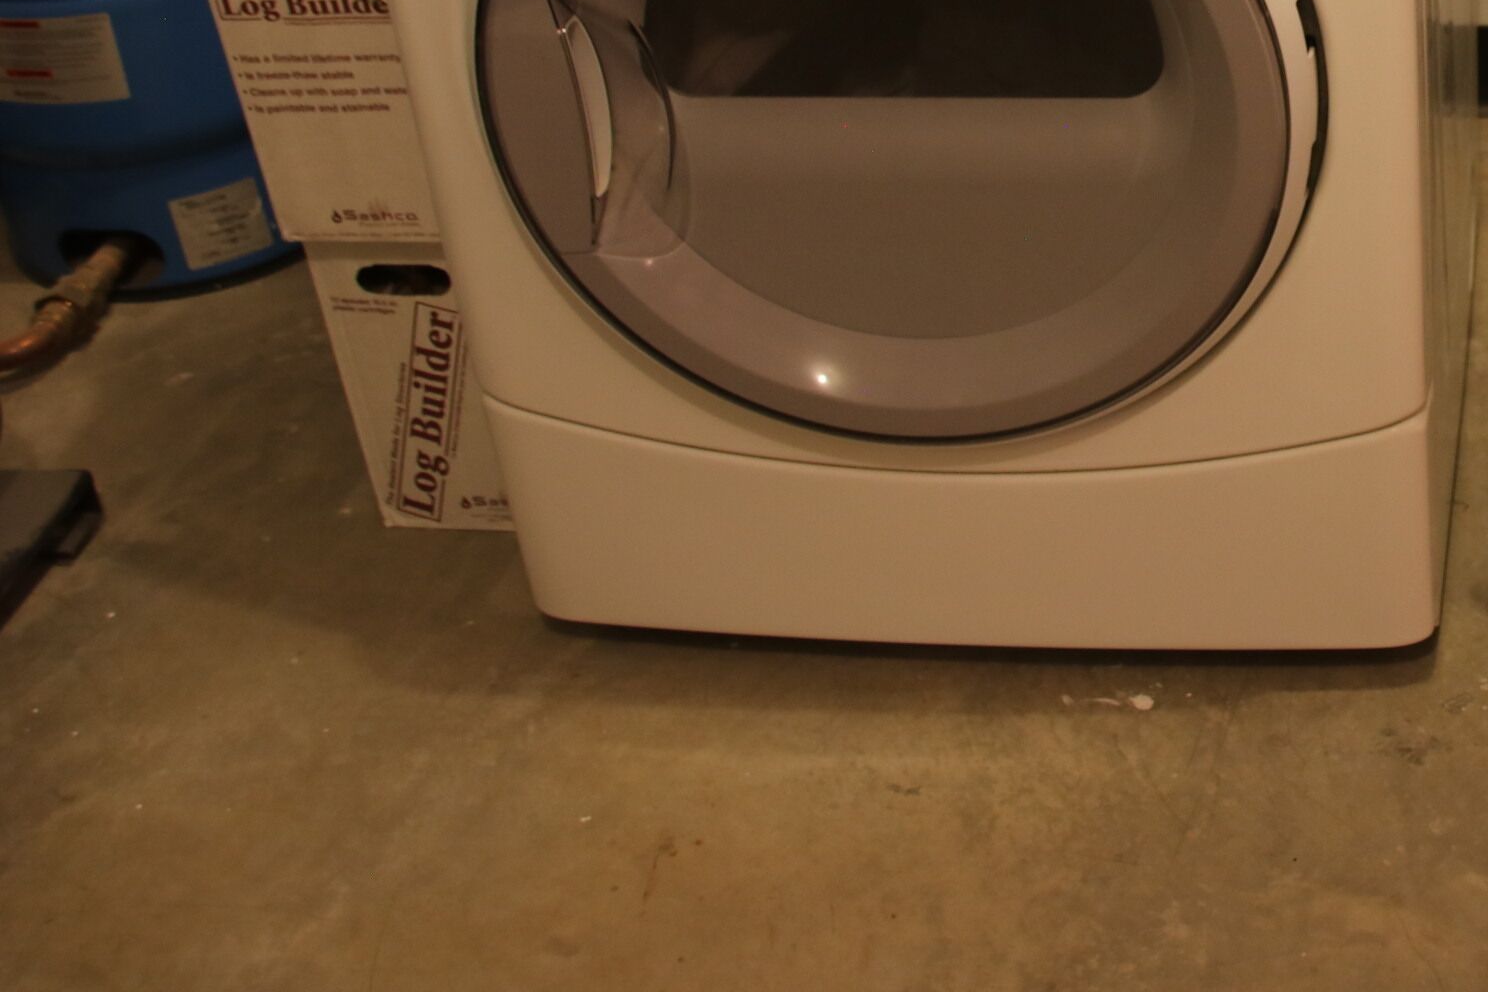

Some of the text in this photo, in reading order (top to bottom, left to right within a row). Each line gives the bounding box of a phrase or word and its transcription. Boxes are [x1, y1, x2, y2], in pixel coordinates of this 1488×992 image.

[361, 86, 381, 96] and
[383, 87, 408, 96] wate
[319, 103, 339, 113] and
[402, 310, 455, 515] Log Builder
